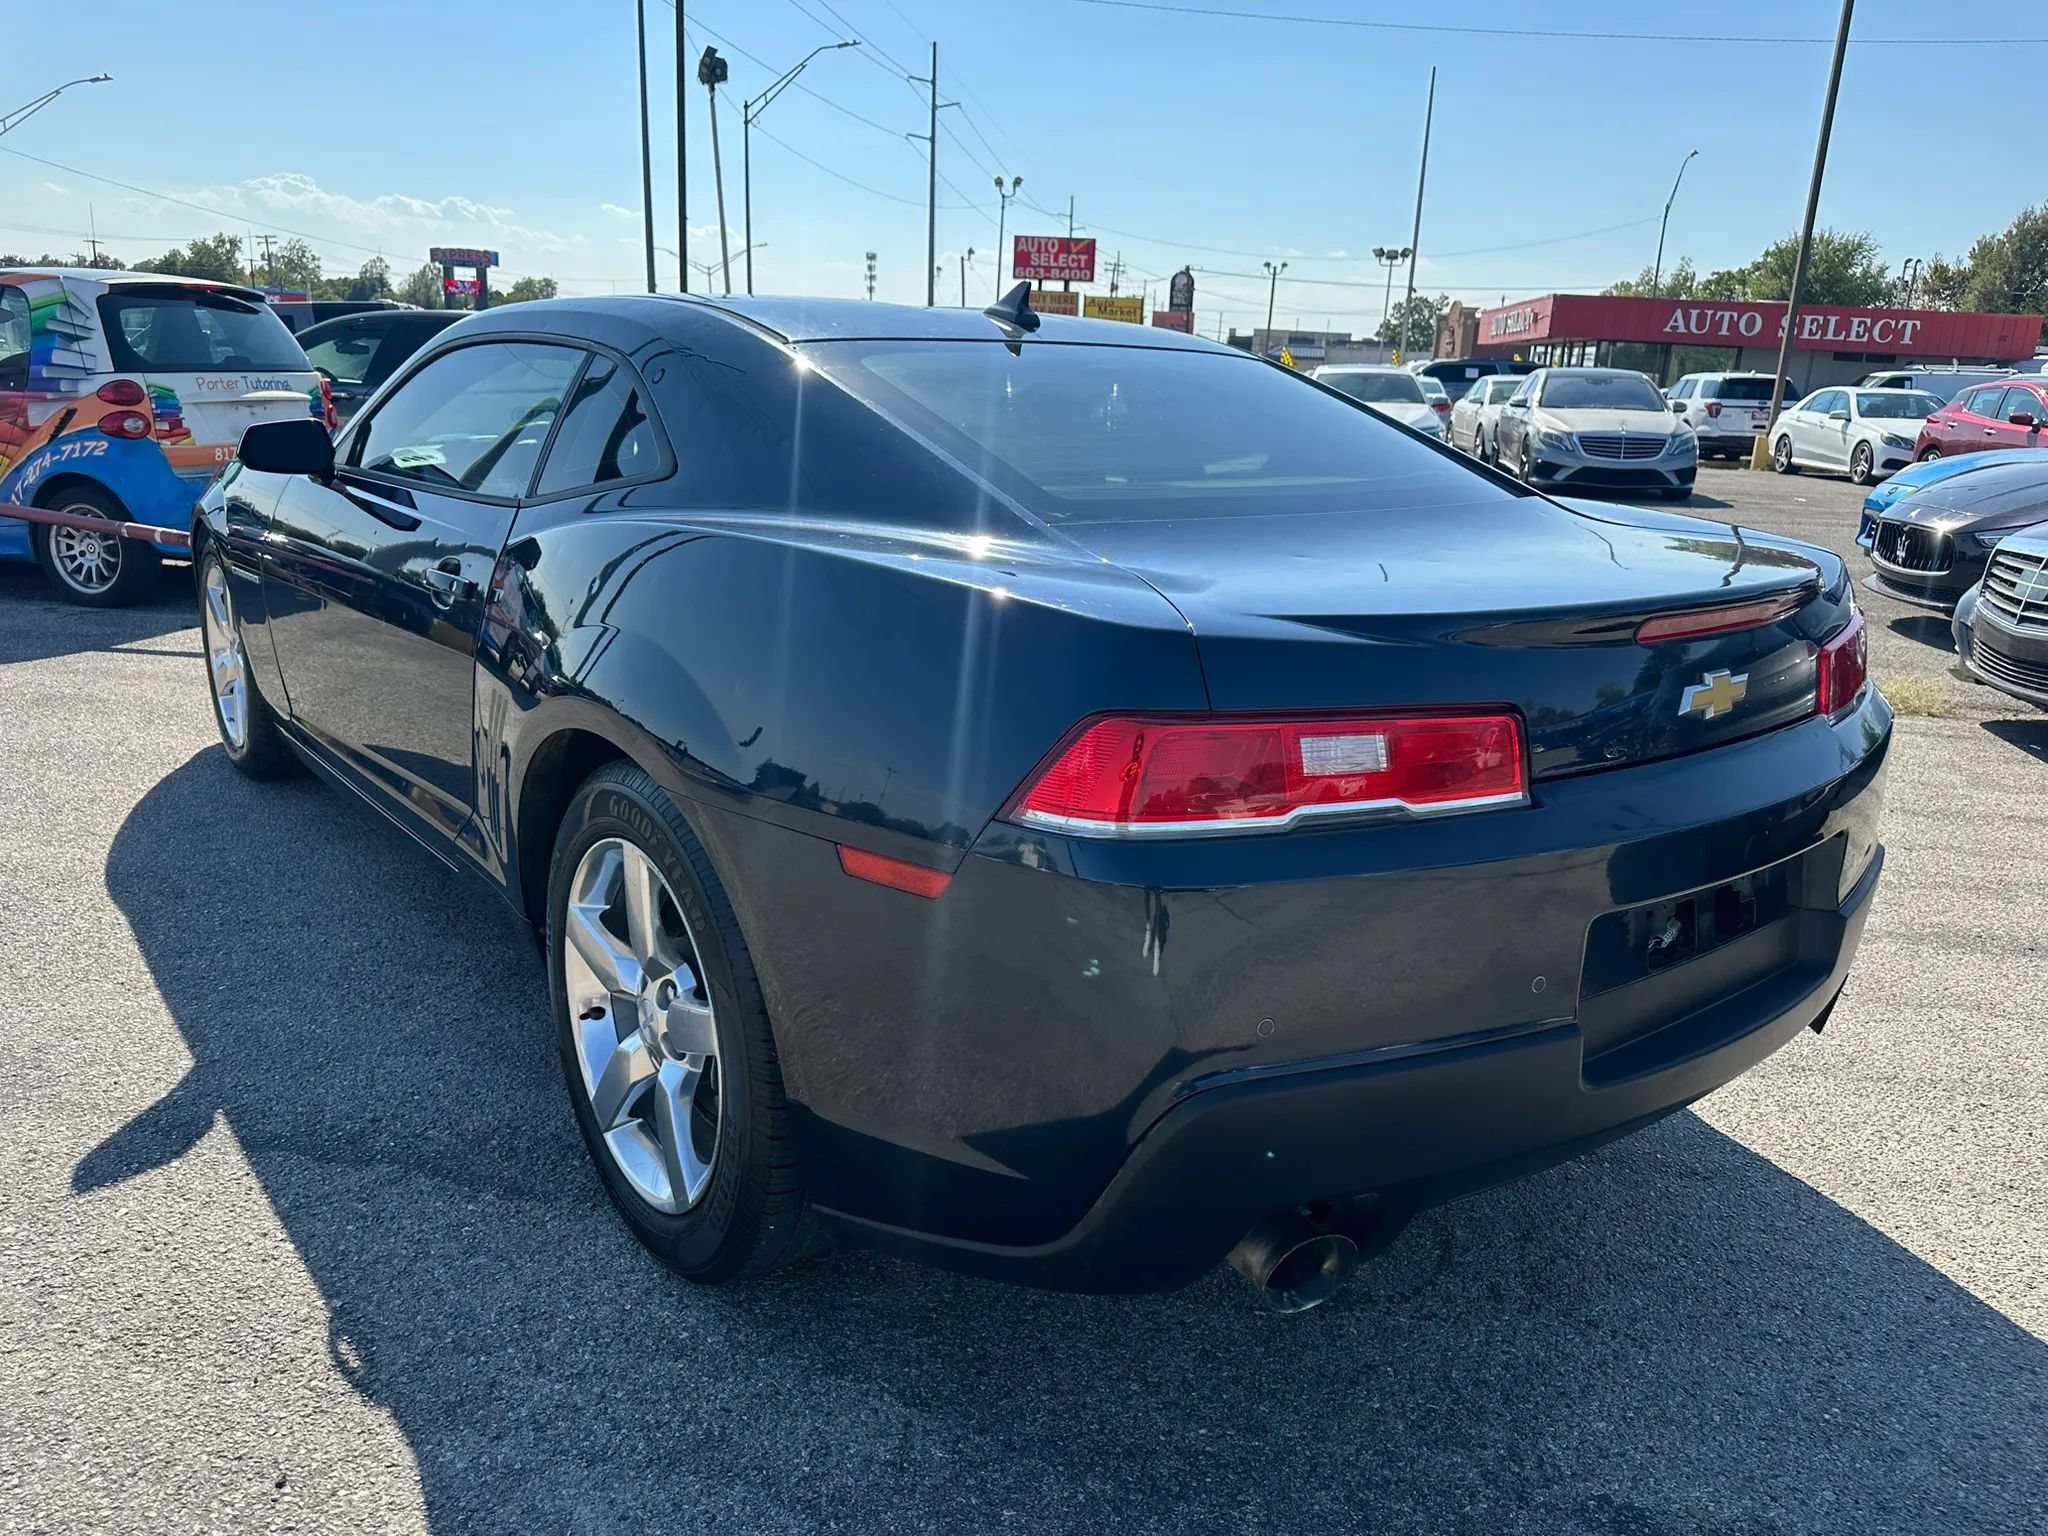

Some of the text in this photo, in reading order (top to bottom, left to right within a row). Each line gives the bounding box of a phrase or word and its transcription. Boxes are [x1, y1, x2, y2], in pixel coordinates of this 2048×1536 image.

[1017, 237, 1060, 253] AUTO
[432, 250, 491, 263] EXPRESS
[1030, 252, 1089, 268] SELECT
[1014, 267, 1091, 280] 603-8400
[1087, 298, 1114, 307] Auto
[1098, 305, 1137, 317] Market
[1663, 308, 1921, 345] AUTO SELECT
[196, 375, 292, 391] Porter Tutoring
